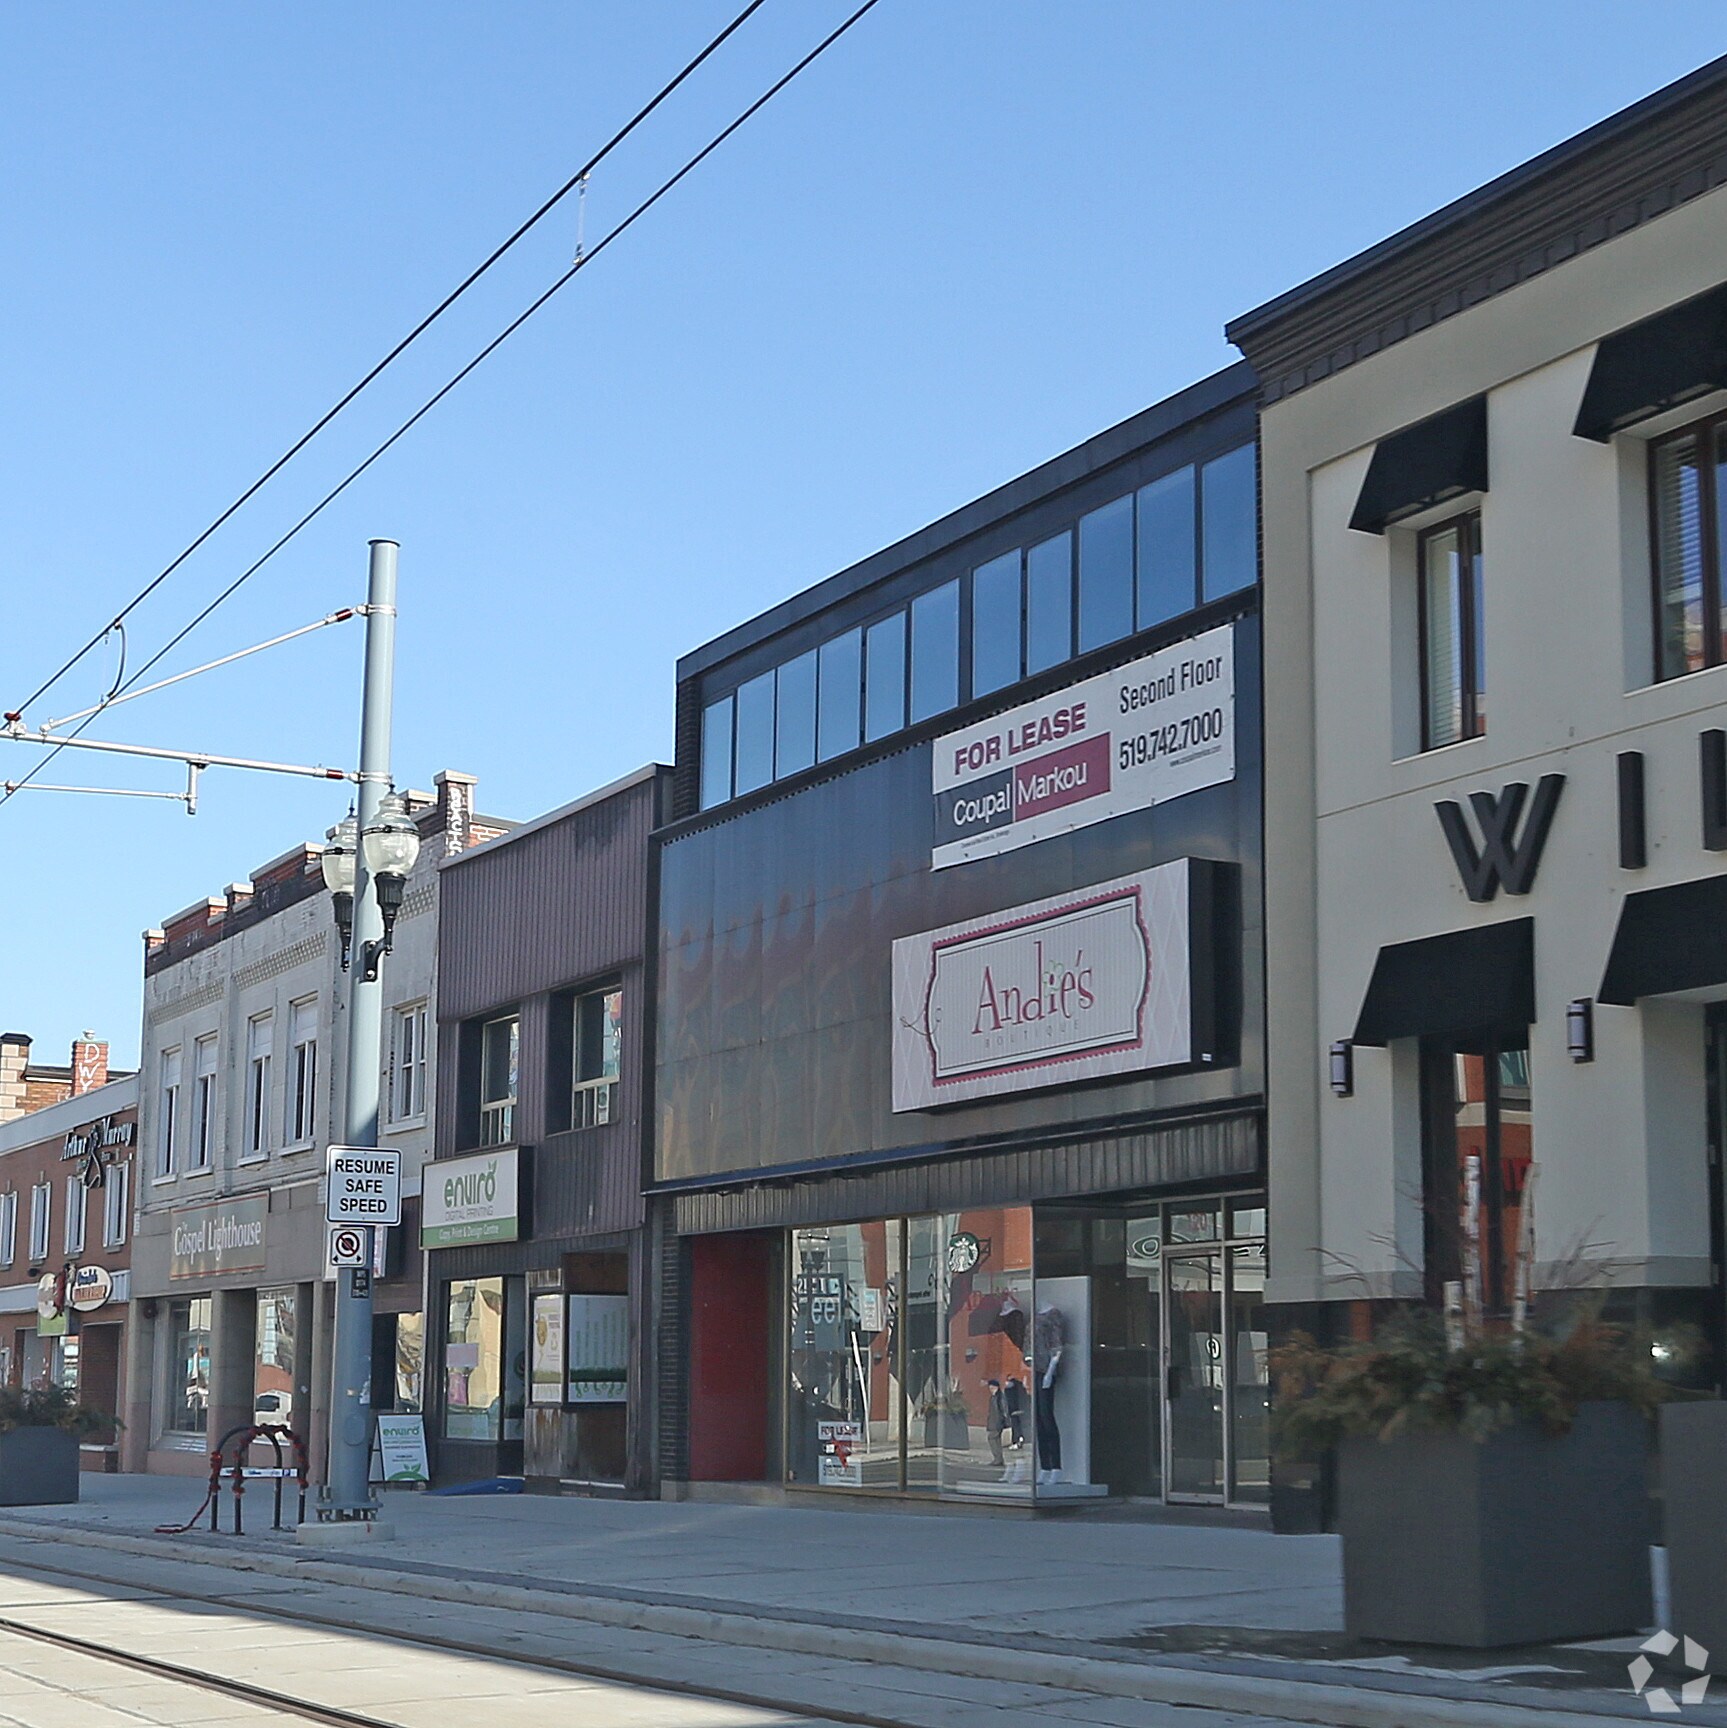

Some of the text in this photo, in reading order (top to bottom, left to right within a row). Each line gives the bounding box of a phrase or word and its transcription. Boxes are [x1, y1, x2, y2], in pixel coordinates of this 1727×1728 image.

[1120, 655, 1222, 714] Second Floor
[954, 701, 1087, 776] FOR LEASE
[1119, 707, 1223, 770] 519.742.7000
[953, 783, 1011, 827] Coupal
[1017, 762, 1087, 806] Markou
[971, 940, 1095, 1035] Andie's
[335, 1158, 395, 1175] RESUME
[345, 1178, 383, 1194] SAFE
[339, 1197, 387, 1213] SPEED
[174, 1214, 262, 1265] Gospel Lighthouse
